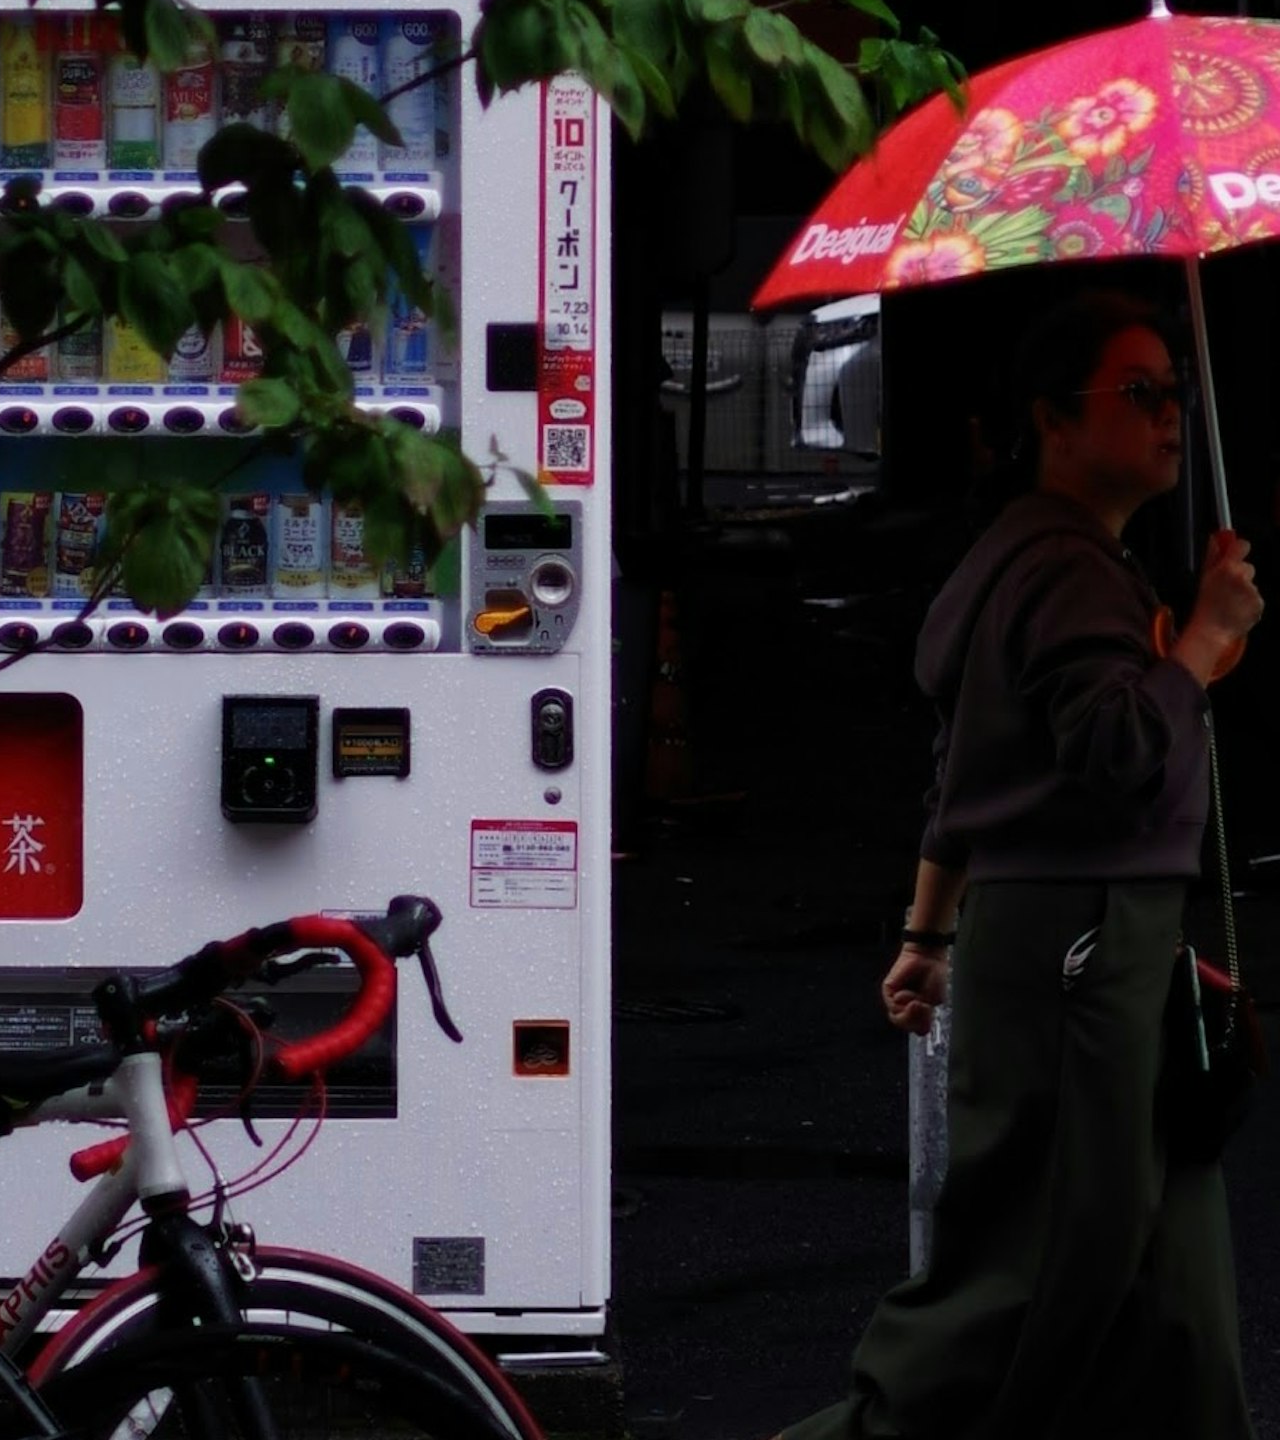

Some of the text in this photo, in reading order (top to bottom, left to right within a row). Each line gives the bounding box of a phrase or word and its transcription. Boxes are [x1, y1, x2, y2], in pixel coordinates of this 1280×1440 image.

[403, 22, 429, 37] 600
[554, 118, 584, 146] 10
[557, 181, 580, 290] クーポン
[223, 544, 265, 558] BLACK
